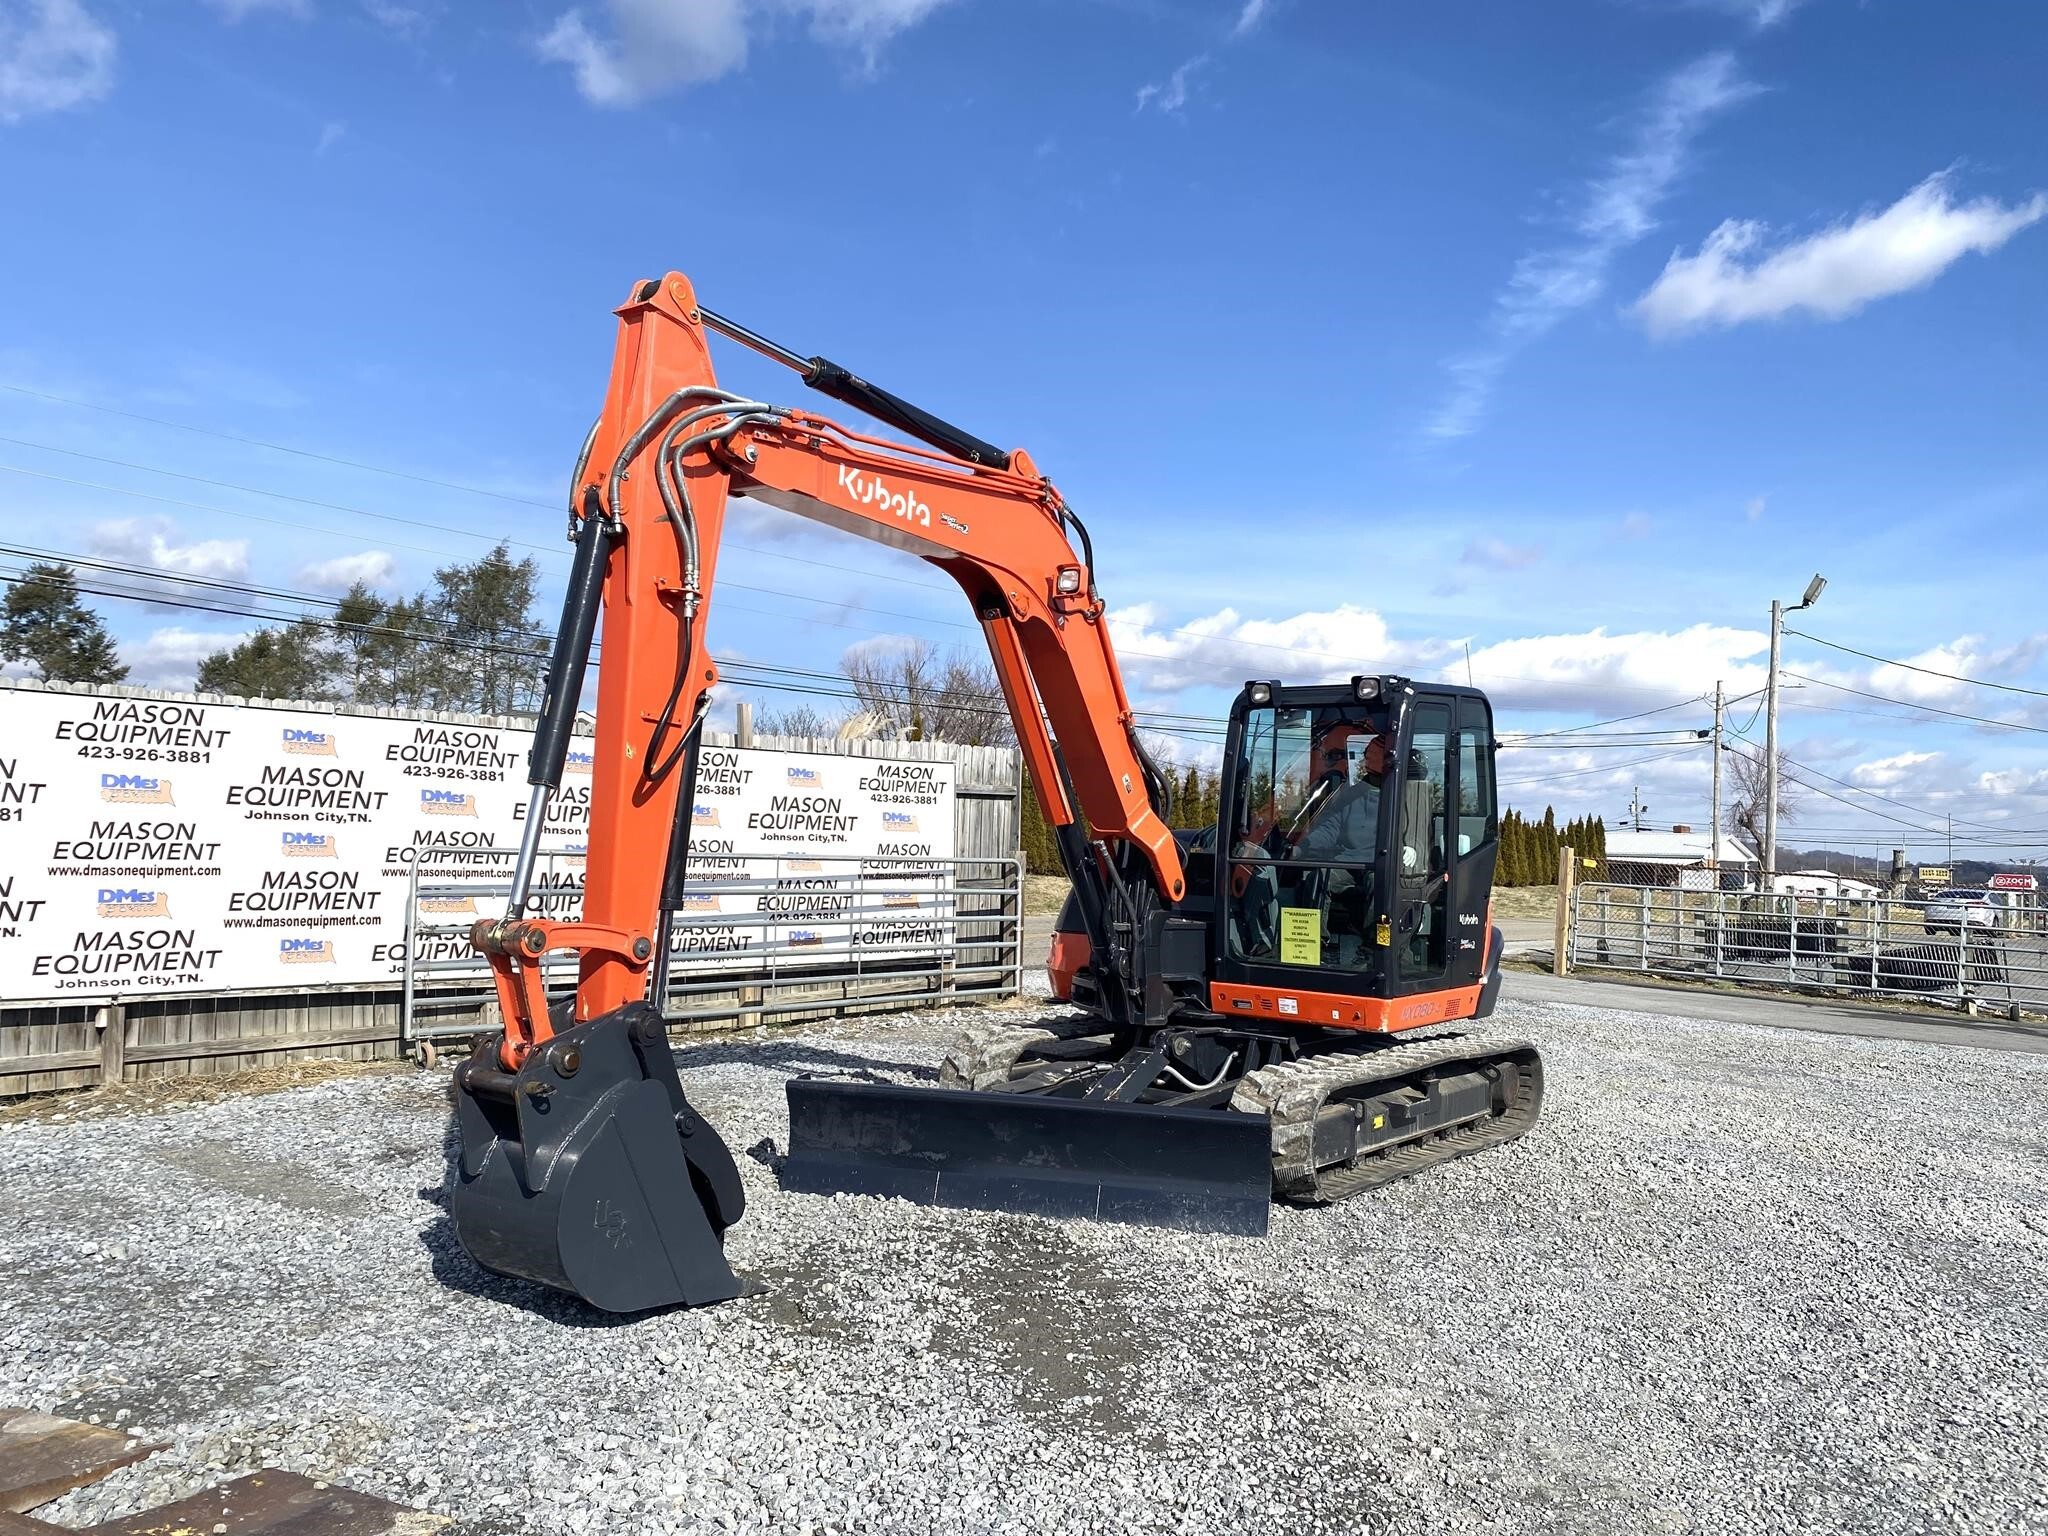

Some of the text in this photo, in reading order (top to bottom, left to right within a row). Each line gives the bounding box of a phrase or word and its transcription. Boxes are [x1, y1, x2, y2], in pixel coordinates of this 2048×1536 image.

[839, 463, 931, 528] Kubota
[93, 701, 205, 726] MASON
[55, 720, 231, 748] EQUIPMENT
[282, 728, 326, 743] DMes
[413, 727, 499, 750] MASON
[77, 745, 210, 764] 423-926-3881
[385, 744, 520, 769] EQUIPMENT
[700, 752, 739, 768] SON
[261, 765, 364, 788] MASON
[402, 765, 505, 782] 423-926-3881
[696, 767, 753, 784] PMENT
[877, 764, 934, 780] MASON
[101, 773, 159, 790] DMes
[696, 784, 741, 796] 26-3881
[859, 777, 947, 794] EQUIPMENT
[225, 785, 388, 810] EQUIPMENT
[420, 789, 465, 804] DMes
[770, 795, 841, 814] MASON
[870, 793, 938, 805] 423-926-3881
[244, 810, 372, 824] Johnson City,TN.
[692, 804, 711, 815] Mes
[89, 821, 197, 841] MASON
[543, 825, 582, 836] hnson
[748, 813, 858, 832] EQUIPMENT
[282, 831, 326, 845] DMes
[412, 830, 496, 848] MASON
[688, 839, 734, 854] ASON
[760, 833, 848, 844] Johnson City,TN.
[53, 841, 221, 861] EQUIPMENT
[877, 843, 932, 856] MASON
[47, 864, 221, 879] www.dmasonequipment.com
[686, 858, 748, 869] IPMENT
[261, 871, 359, 890] MASON
[381, 867, 515, 880] www.masonequipment.com
[685, 871, 751, 882] sonequipment.com
[97, 888, 155, 904] DMes
[228, 891, 381, 912] EQUIPMENT
[756, 896, 853, 911] EQUIPMENT
[224, 914, 382, 930] www.dmasonequipment.com
[73, 929, 195, 952] MASON
[280, 938, 323, 952] DMes
[670, 936, 752, 953] UIPMENT
[853, 930, 944, 945] EQUIPMENT
[32, 949, 223, 976] EQUIPMENT
[54, 972, 204, 989] Johnson City,TN.
